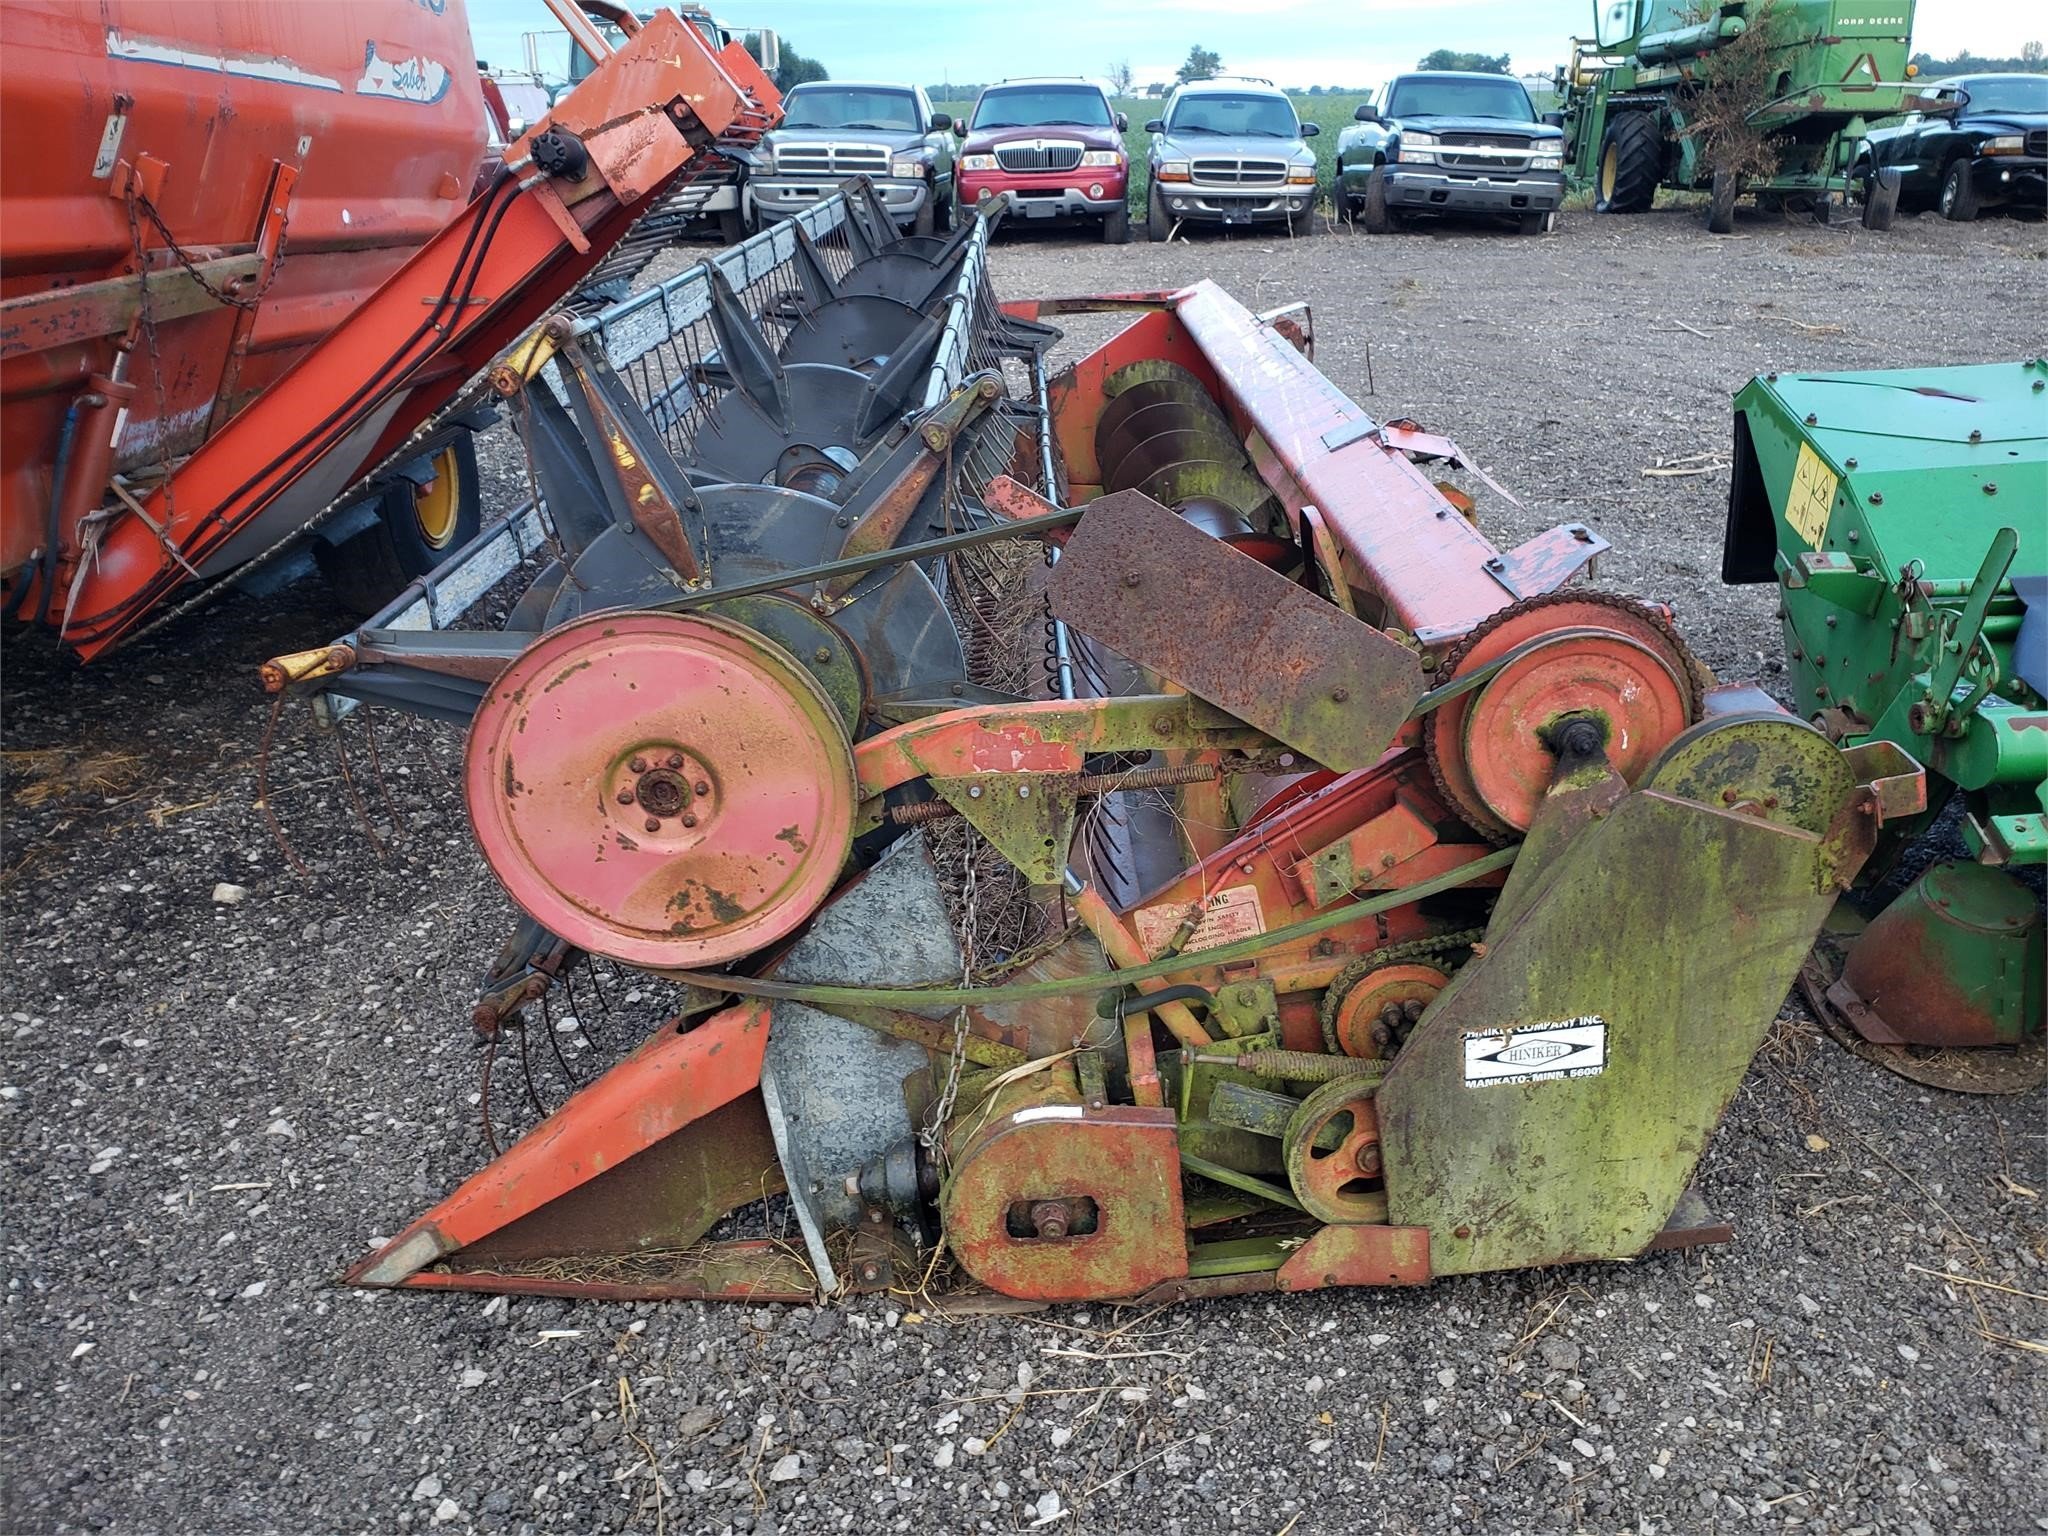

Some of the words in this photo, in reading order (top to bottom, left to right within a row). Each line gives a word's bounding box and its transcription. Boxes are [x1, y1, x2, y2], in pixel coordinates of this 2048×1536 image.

[1869, 17, 1903, 25] DEERE
[1516, 1017, 1577, 1033] COMPANY
[1509, 1045, 1561, 1061] HINIKER
[1569, 1066, 1603, 1078] 56001
